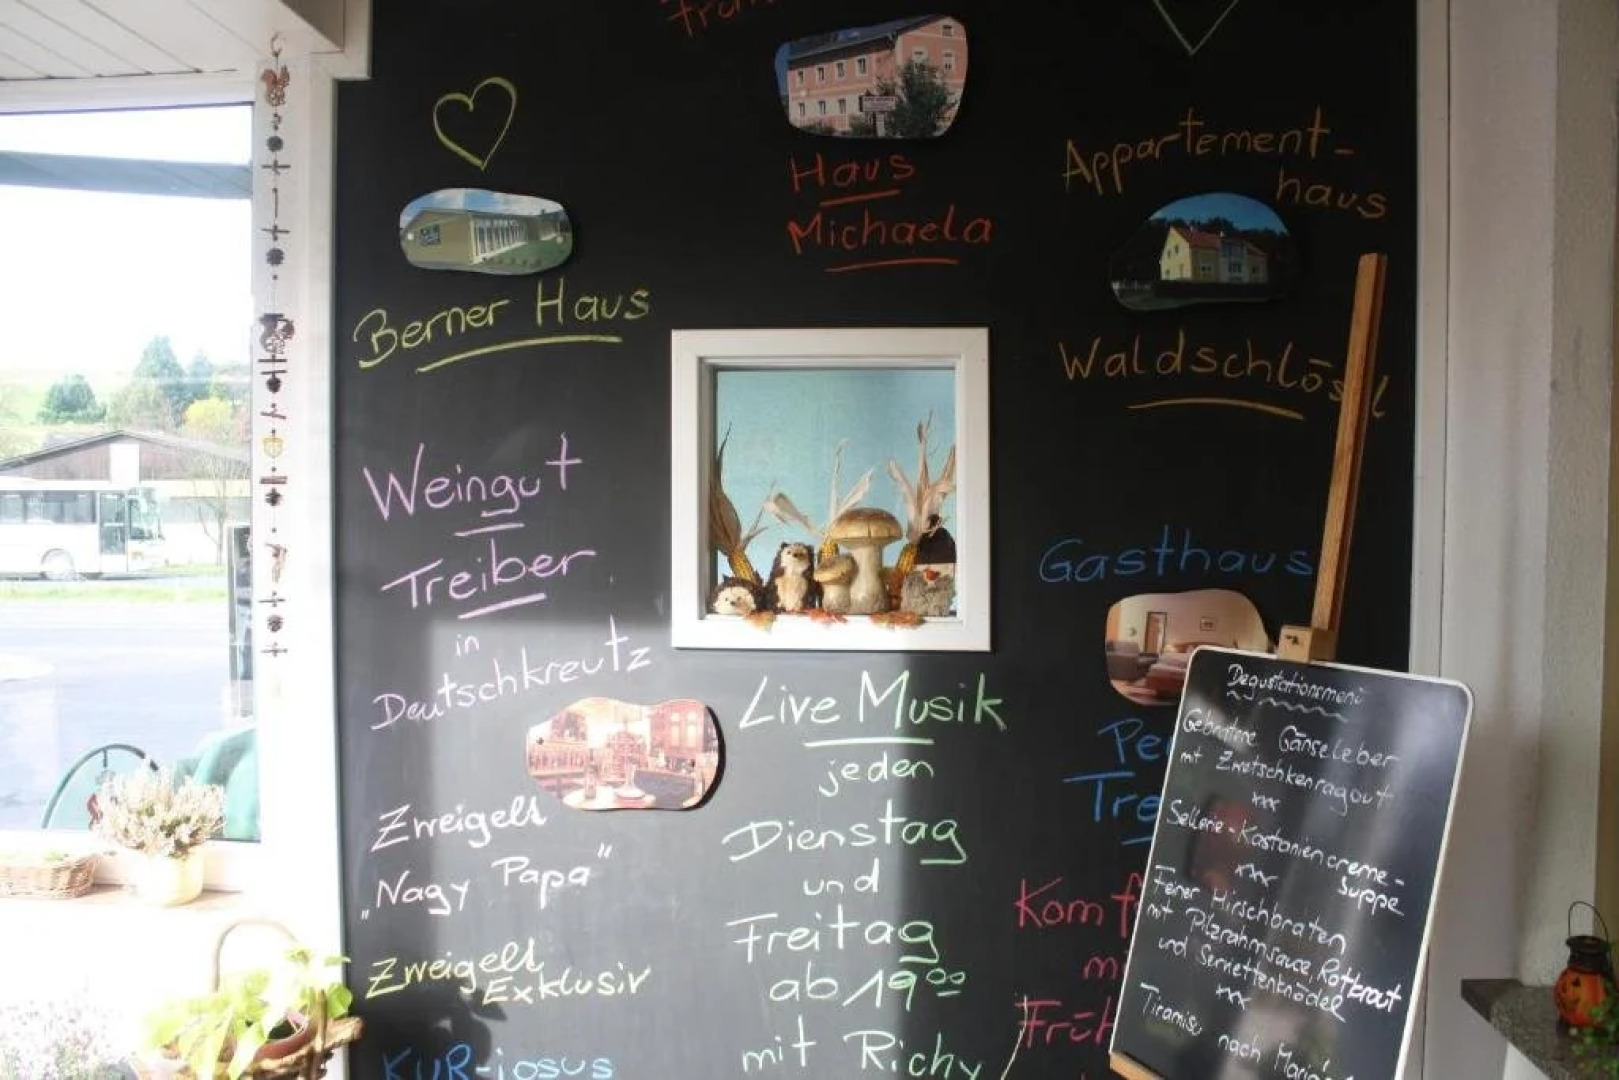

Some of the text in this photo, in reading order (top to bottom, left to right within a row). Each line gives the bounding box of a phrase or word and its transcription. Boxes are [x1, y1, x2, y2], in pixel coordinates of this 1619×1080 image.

[788, 153, 915, 191] Haus
[1276, 167, 1388, 218] haus
[787, 204, 995, 255] Michaela
[353, 277, 651, 368] Berner Haus
[363, 432, 583, 521] Weingut
[381, 538, 597, 608] Treiber
[1040, 525, 1314, 583] Gasthaus
[372, 614, 652, 730] Deutschkreutz
[456, 633, 480, 656] in
[739, 670, 1007, 731] Live Musik
[819, 751, 934, 797] jeden
[371, 796, 547, 852] Zweigelt
[722, 799, 967, 865] Dienstag
[802, 857, 880, 896] und
[726, 903, 940, 963] Freitag
[1158, 935, 1188, 958] und
[1211, 887, 1347, 955] Hirschbraten
[366, 937, 545, 1000] Zweigelt
[482, 962, 651, 1006] Exklusiv
[769, 961, 839, 1002] ab
[742, 1015, 982, 1080] mit Richy
[1217, 1033, 1261, 1064] nach
